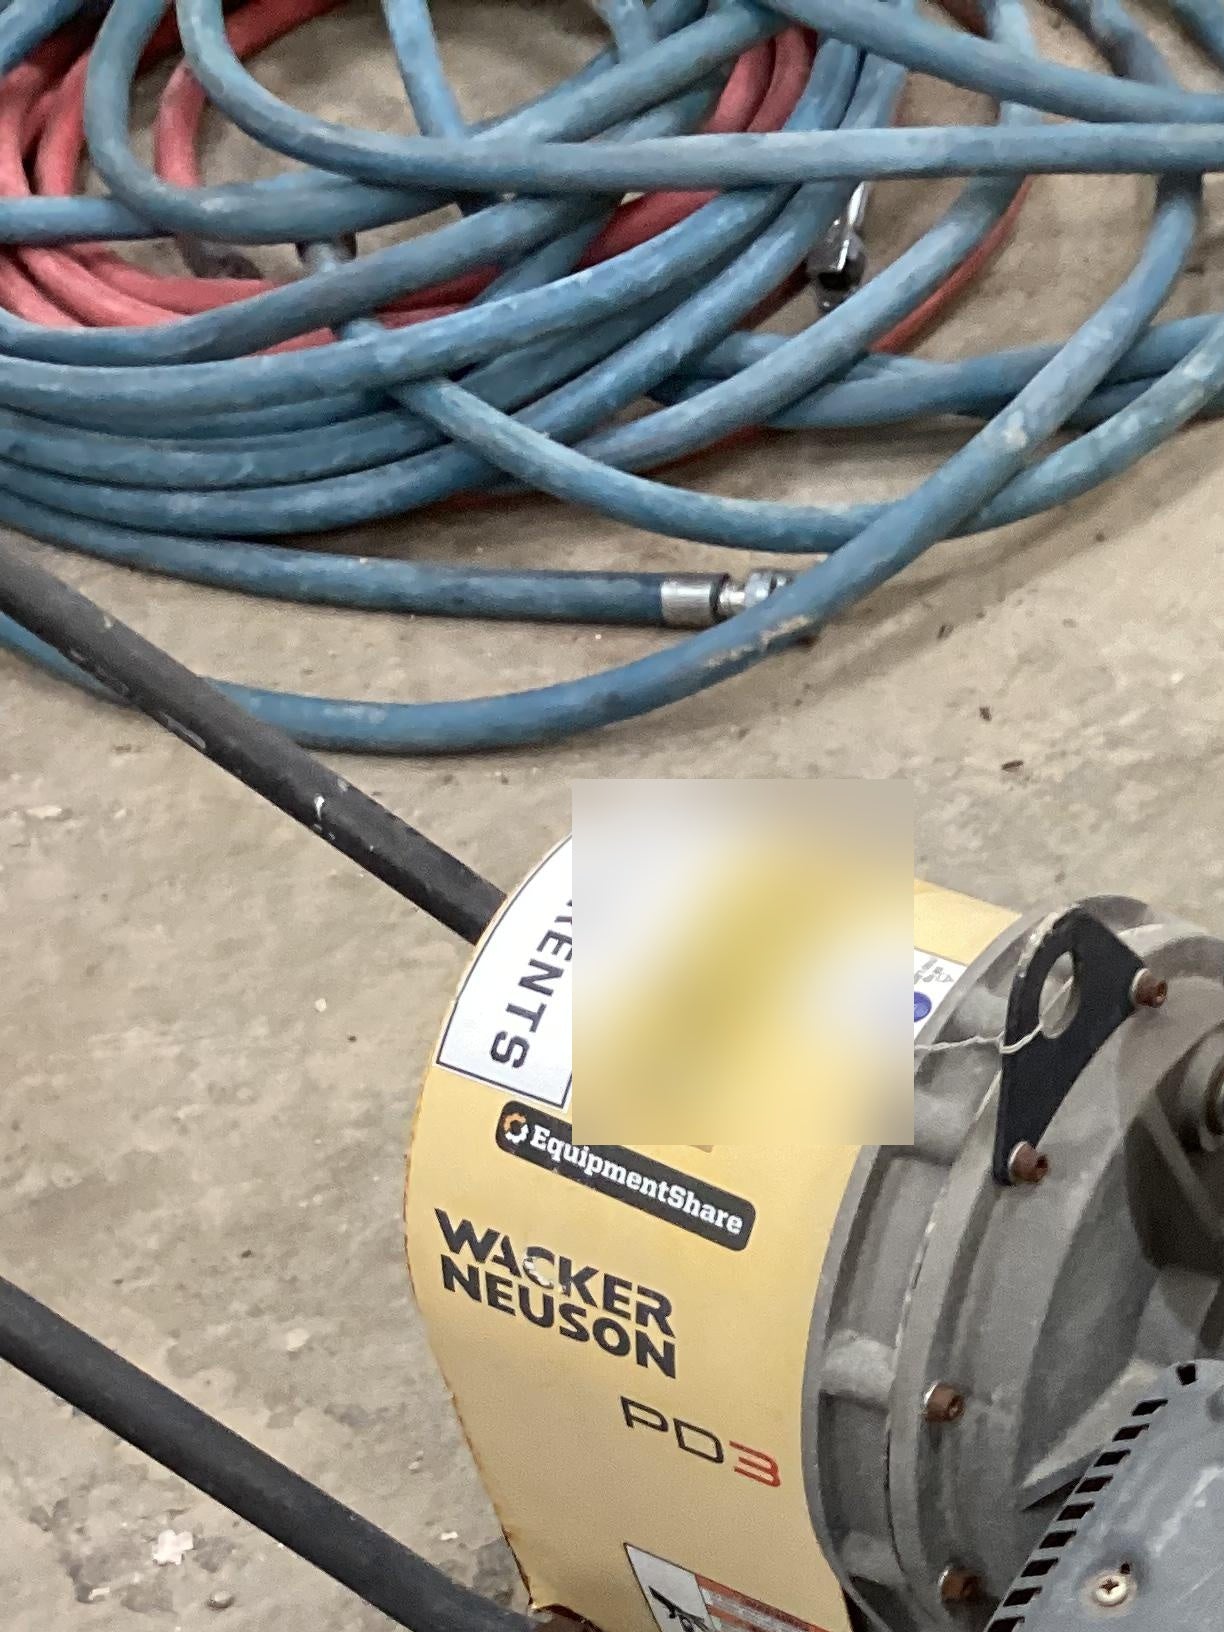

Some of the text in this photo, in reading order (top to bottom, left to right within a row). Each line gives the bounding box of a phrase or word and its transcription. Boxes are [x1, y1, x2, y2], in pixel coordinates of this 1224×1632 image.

[530, 1124, 743, 1235] EquipmentShare
[434, 1208, 676, 1338] WACKER
[440, 1254, 676, 1379] NEUSON
[619, 1395, 781, 1487] PD3
